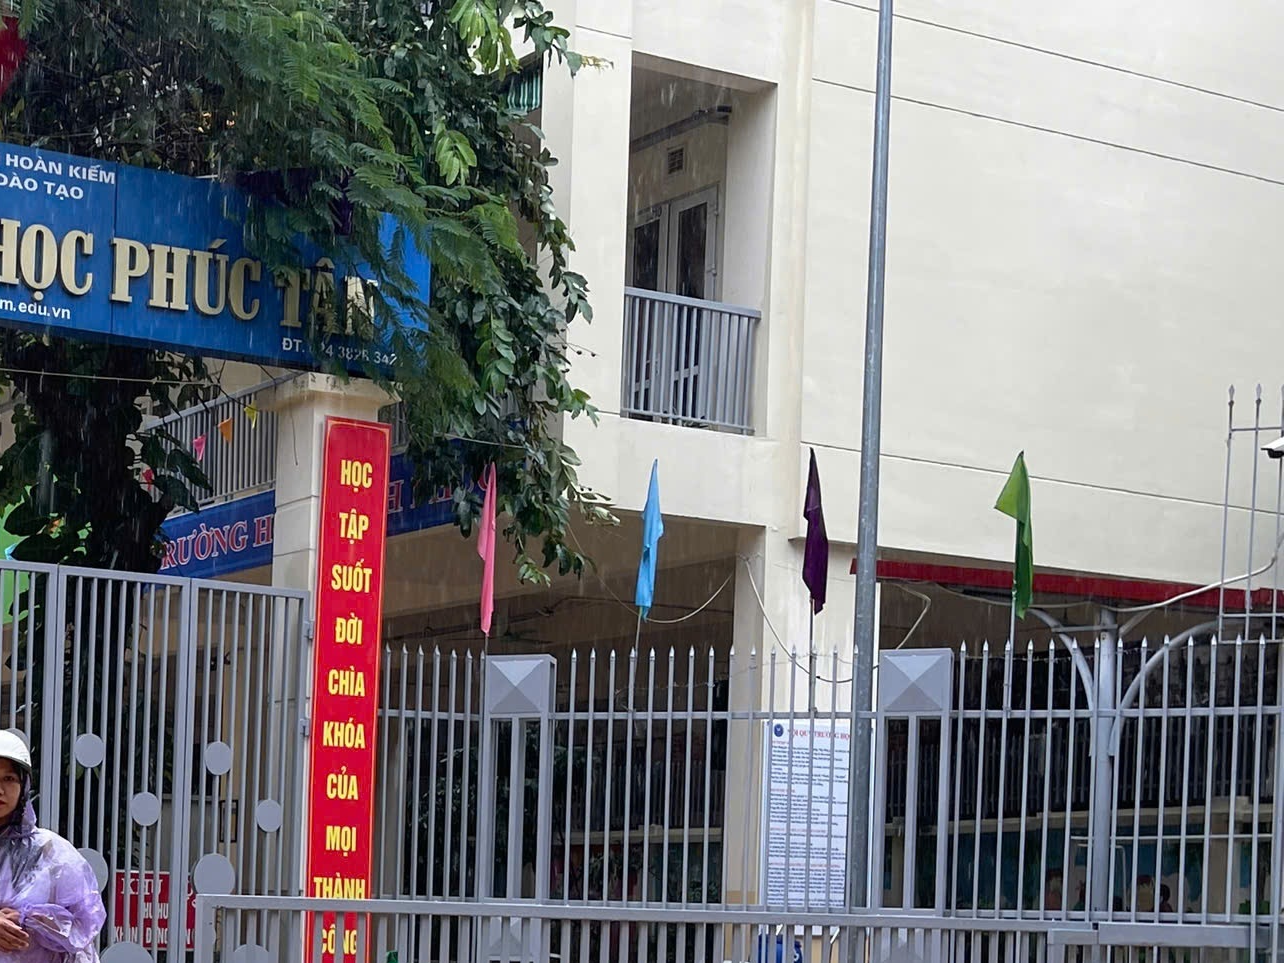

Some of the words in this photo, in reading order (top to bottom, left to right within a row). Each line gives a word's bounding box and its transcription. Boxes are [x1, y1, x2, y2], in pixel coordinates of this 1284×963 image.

[6, 153, 62, 175] HOÀN
[68, 164, 116, 185] KIẾM
[43, 180, 84, 201] TẠO
[110, 238, 262, 322] PHÚC
[340, 459, 373, 493] HỌC
[339, 508, 369, 545] TẬP
[159, 520, 248, 570] RƯỜNG
[331, 558, 373, 593] SUỐT
[335, 612, 363, 645] ĐỜI
[327, 665, 366, 697] CHÌA
[322, 718, 366, 749] KHÓA
[326, 765, 359, 800] CỦA
[325, 825, 357, 857] MỌI
[313, 872, 366, 899] THÀNH
